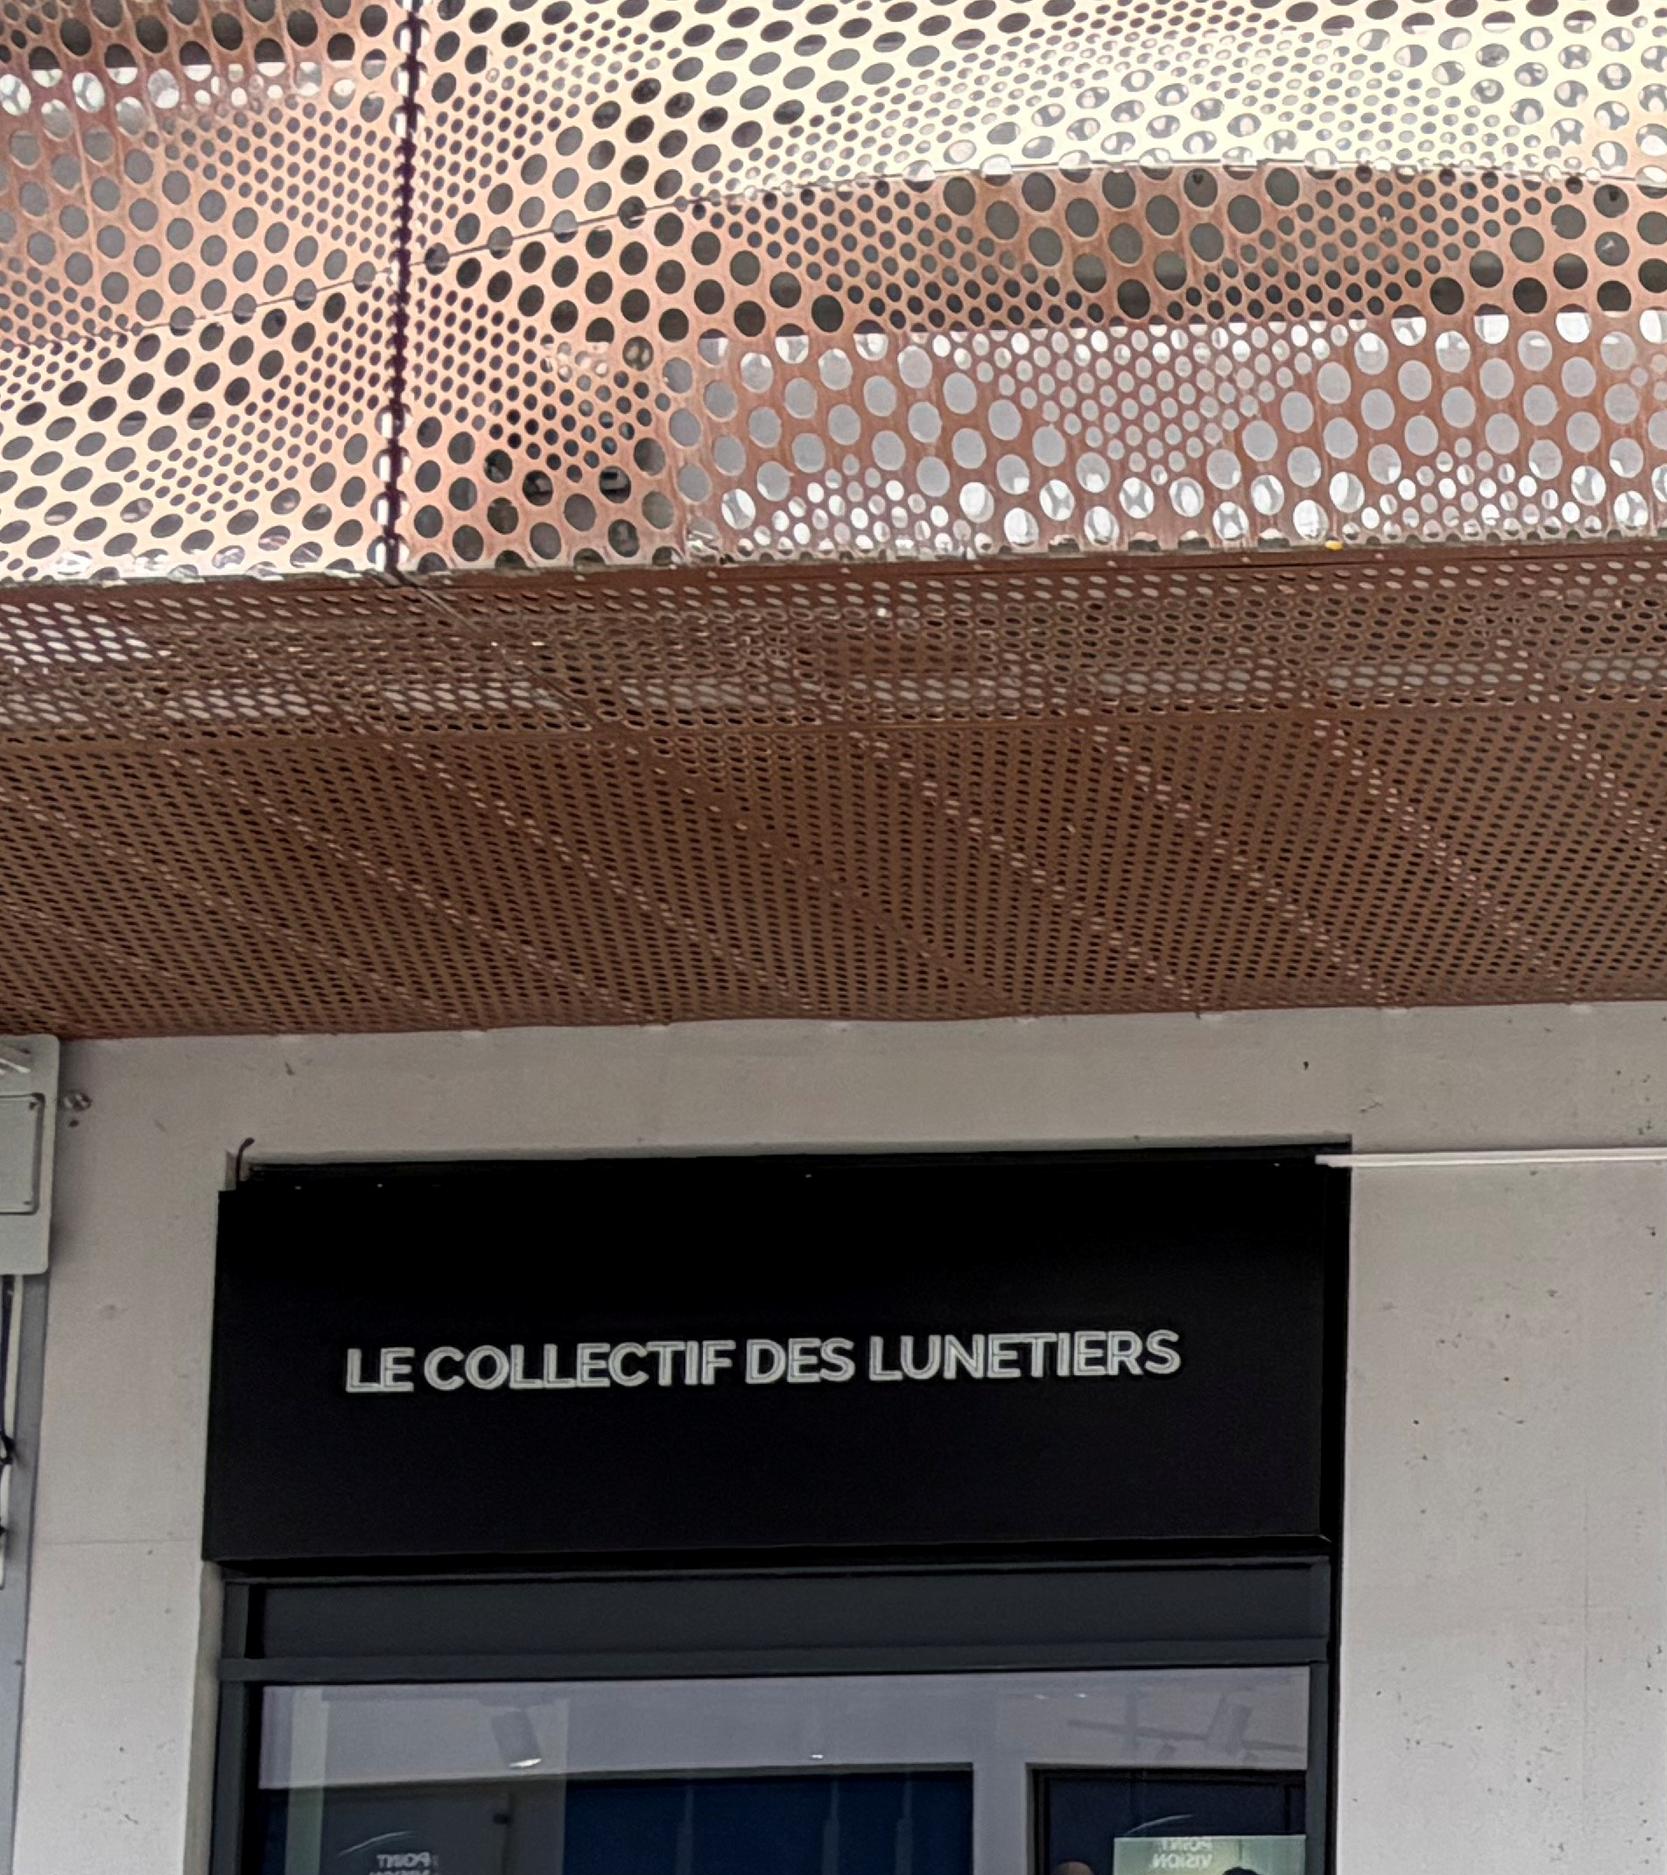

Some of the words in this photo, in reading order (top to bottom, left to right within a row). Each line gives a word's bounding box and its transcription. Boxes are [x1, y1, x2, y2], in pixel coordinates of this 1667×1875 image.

[345, 1346, 415, 1393] LE
[423, 1339, 736, 1390] COLLECTIF
[745, 1336, 855, 1384] DES
[868, 1329, 1182, 1381] LUNETIERS
